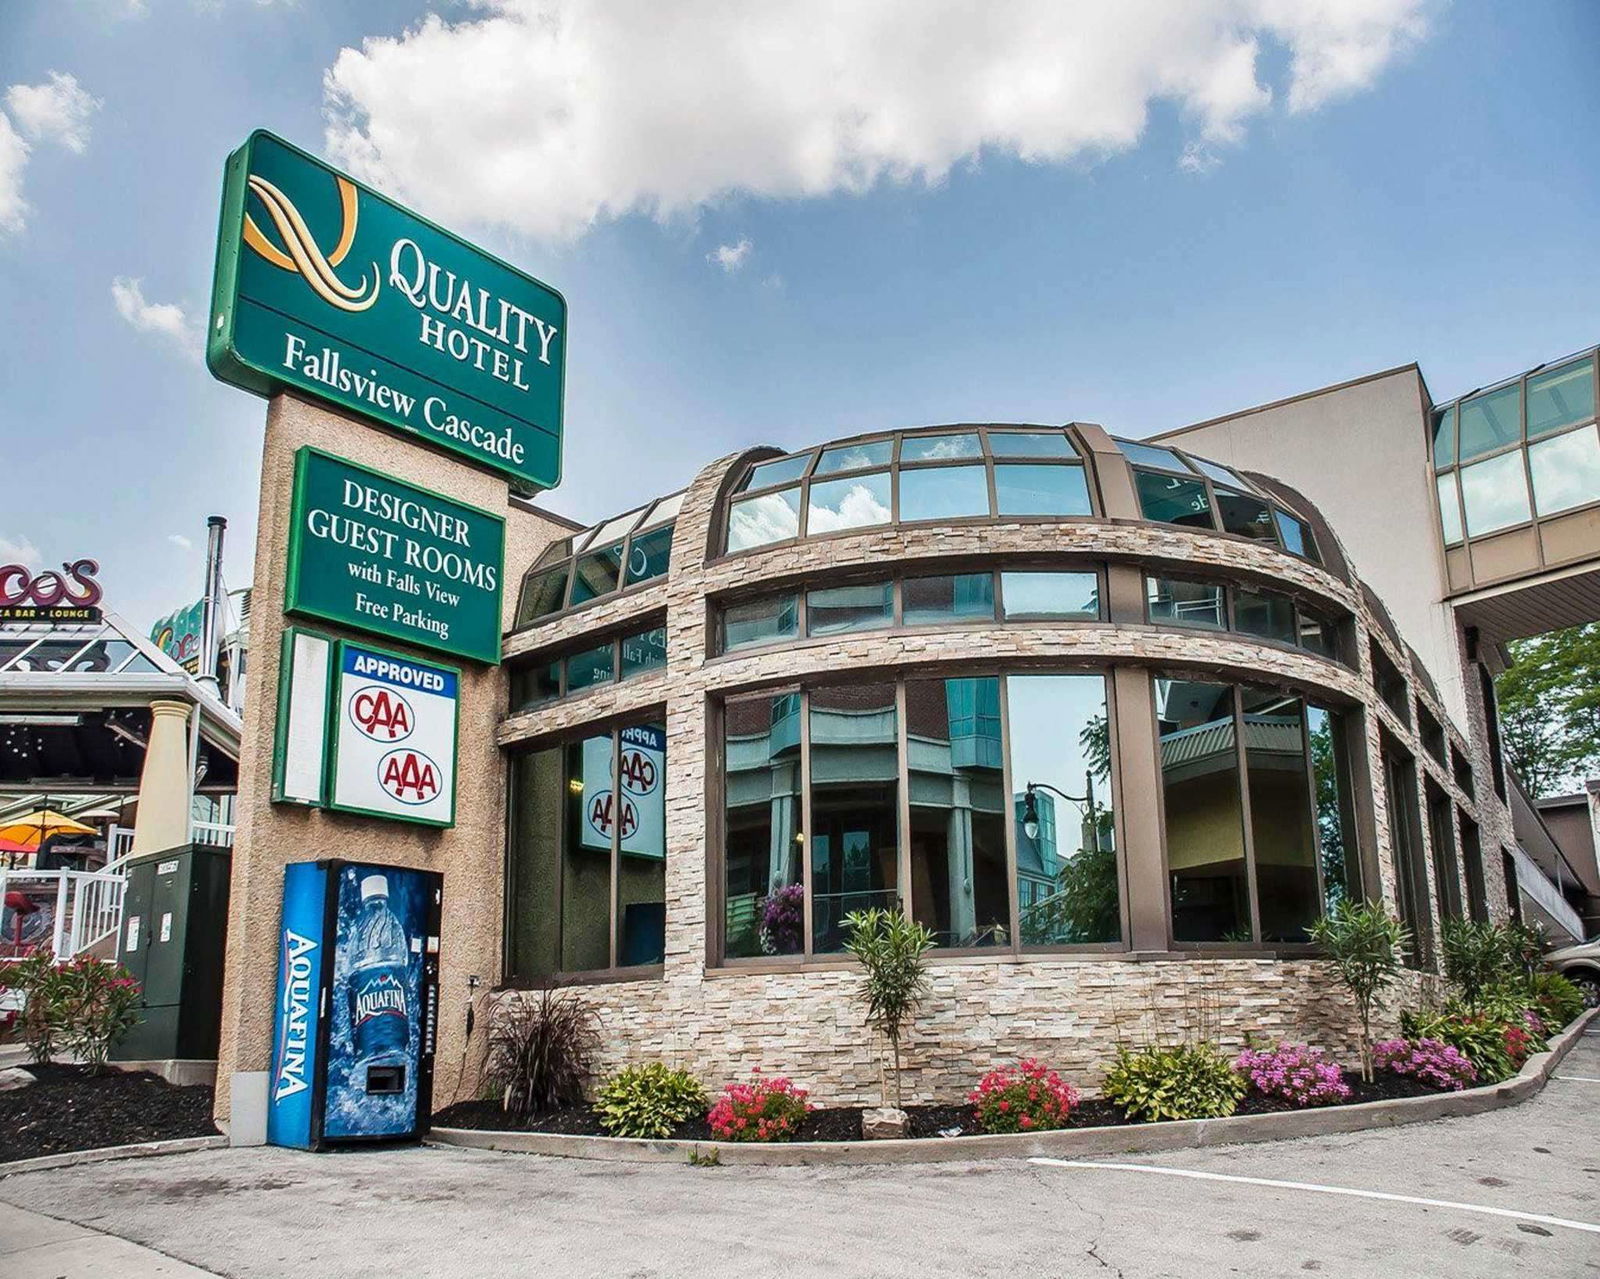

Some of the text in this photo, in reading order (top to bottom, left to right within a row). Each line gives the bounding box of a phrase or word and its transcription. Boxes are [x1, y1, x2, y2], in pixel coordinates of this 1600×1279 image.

[389, 238, 557, 365] QUALITY
[419, 313, 530, 391] HOTEL
[282, 333, 524, 464] Fallsview Cascade
[343, 479, 471, 547] DESIGNER
[308, 509, 496, 591] GUEST ROOMS
[348, 561, 460, 607] with Falls View
[49, 610, 90, 618] LOUNGE
[355, 593, 449, 640] Free Parking
[354, 655, 444, 691] APPROVED
[355, 691, 409, 738] CAA
[383, 753, 436, 800] AAA
[275, 929, 319, 1101] AQUAFINA
[355, 989, 407, 1025] AQUAFINA
